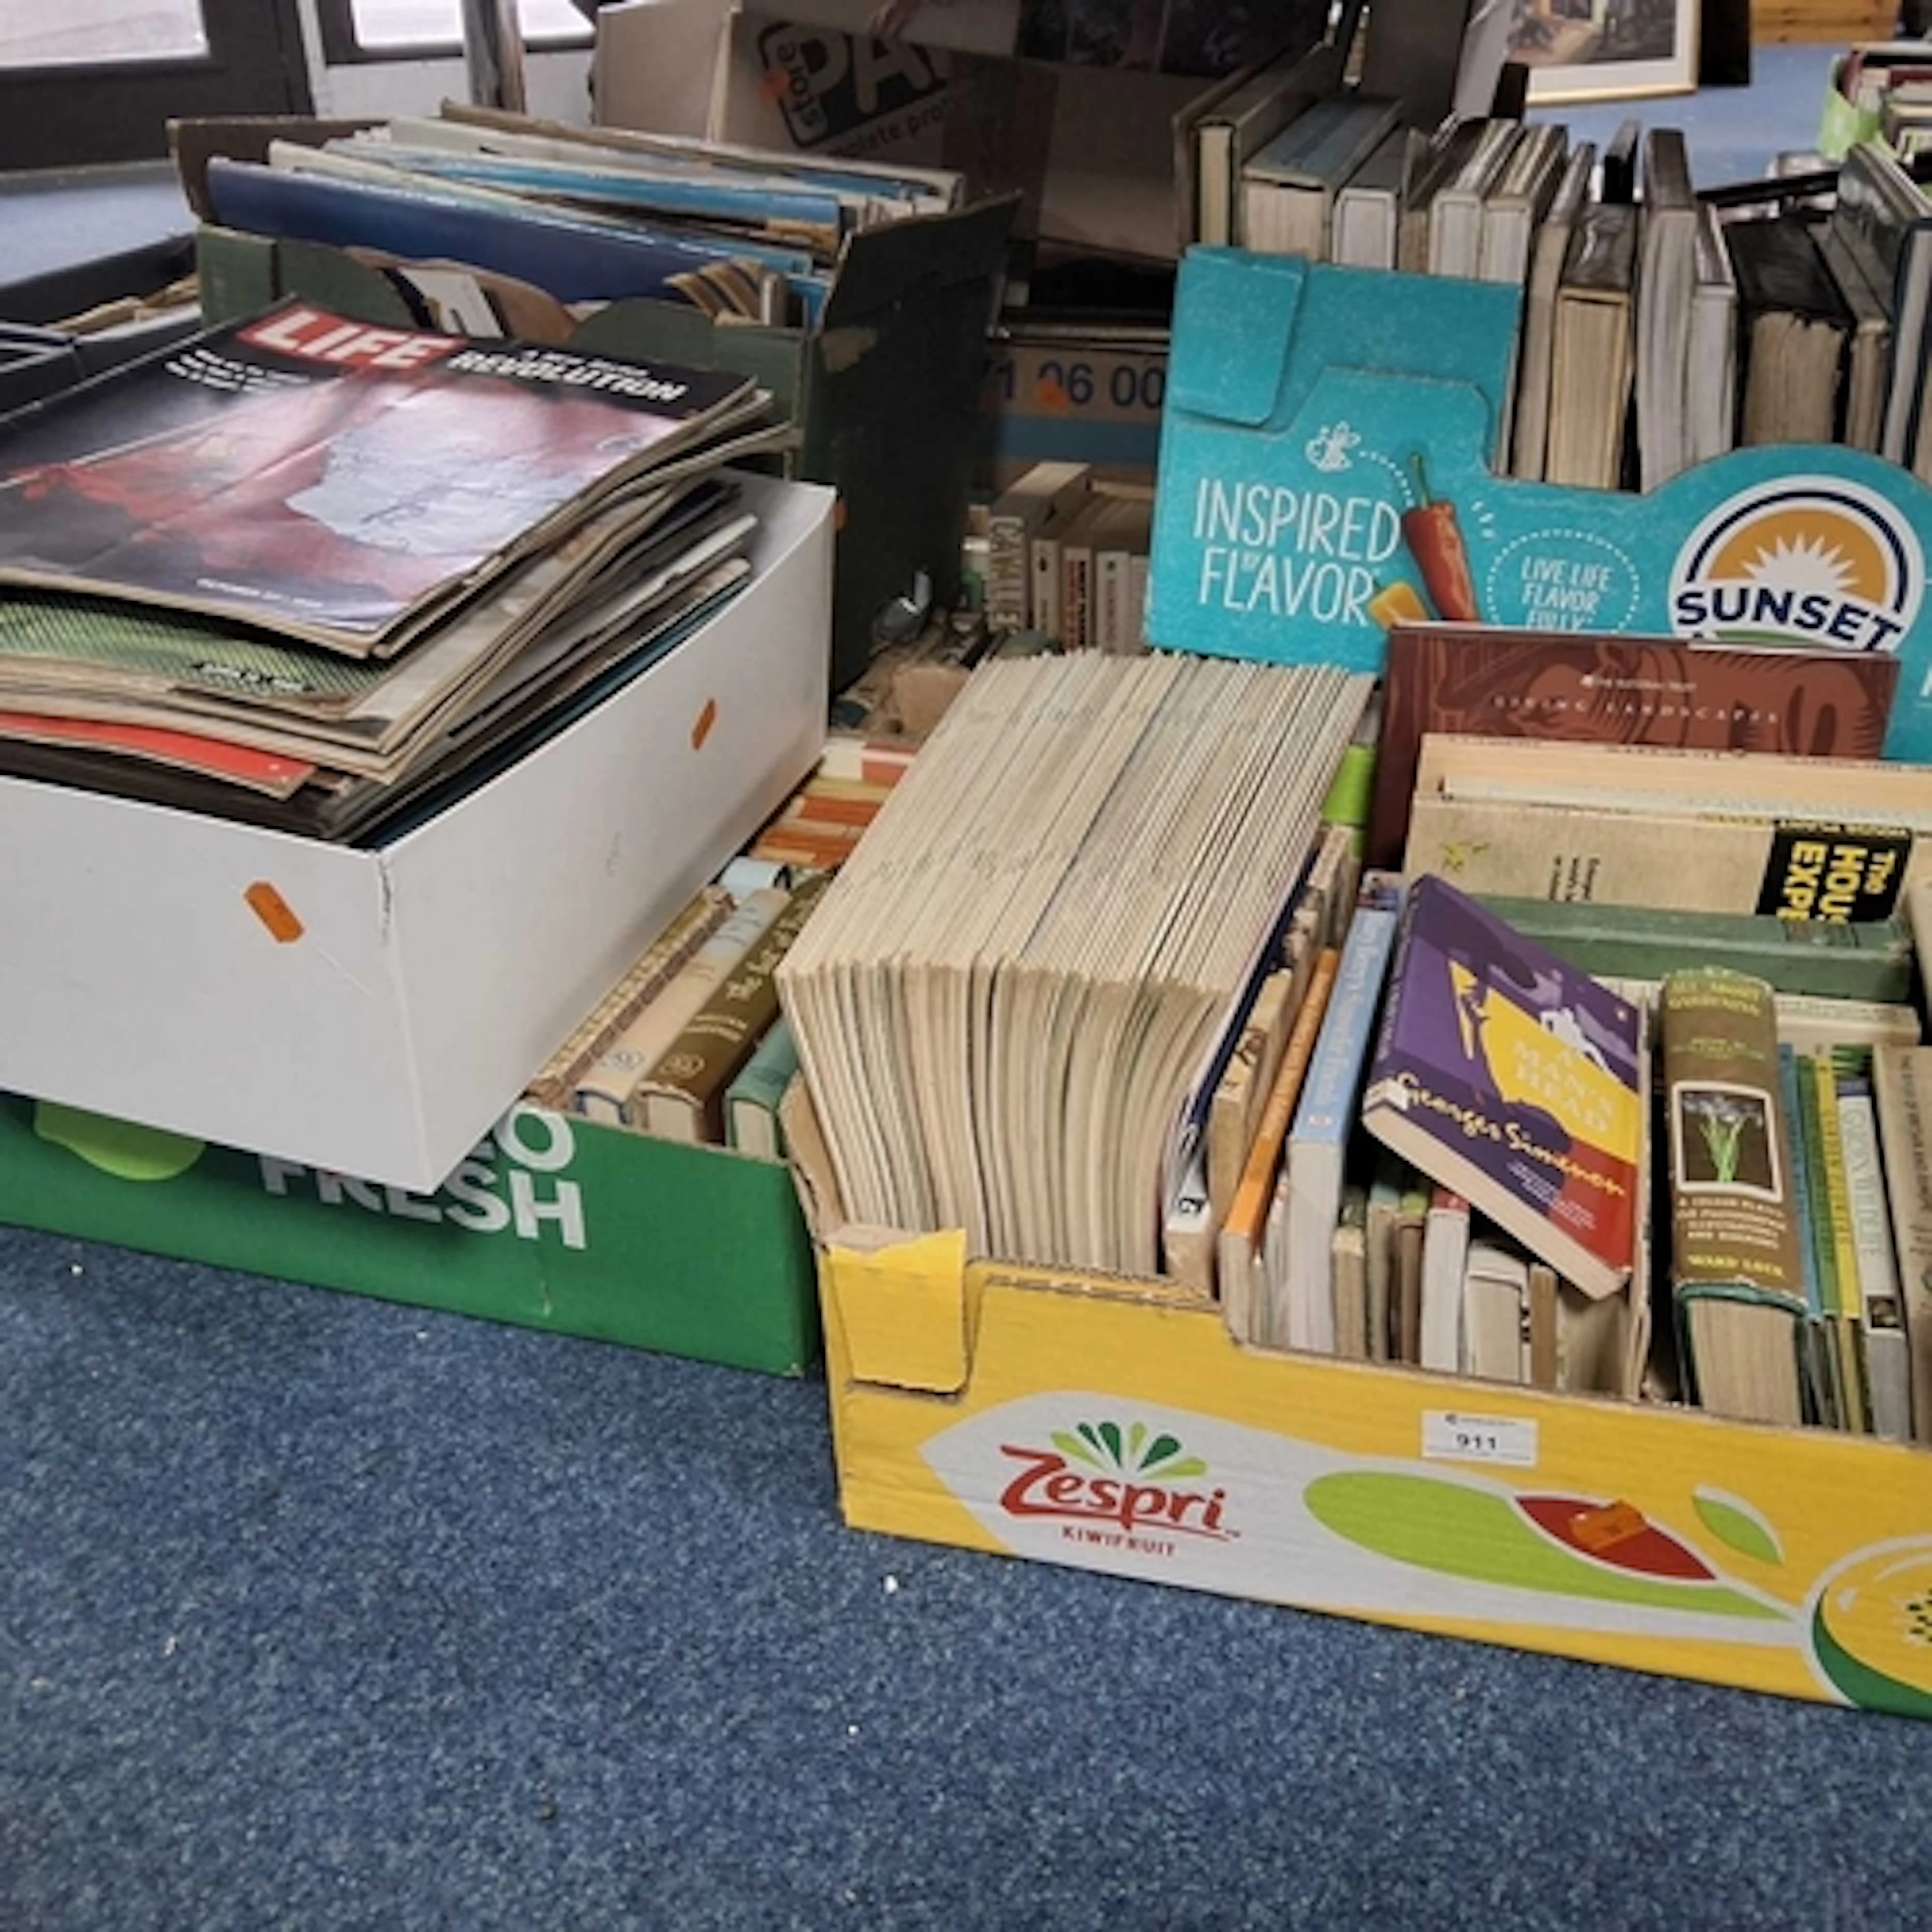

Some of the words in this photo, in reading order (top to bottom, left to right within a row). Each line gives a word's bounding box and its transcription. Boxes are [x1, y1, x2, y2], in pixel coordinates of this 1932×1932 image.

[254, 310, 455, 369] LIFE
[447, 350, 689, 402] REVOLUTION
[1193, 477, 1402, 563] INSPIRED
[1199, 545, 1369, 627] FLAVOR
[1520, 555, 1568, 584] LIVE
[1569, 562, 1614, 592] LIFE
[1521, 582, 1600, 613] FLAVOR
[1675, 587, 1904, 651] SUNSET
[1864, 849, 1896, 895] The
[1457, 1433, 1497, 1451] 911
[1000, 1444, 1229, 1541] Zespri
[1063, 1526, 1176, 1557] KIWIFRUIT
